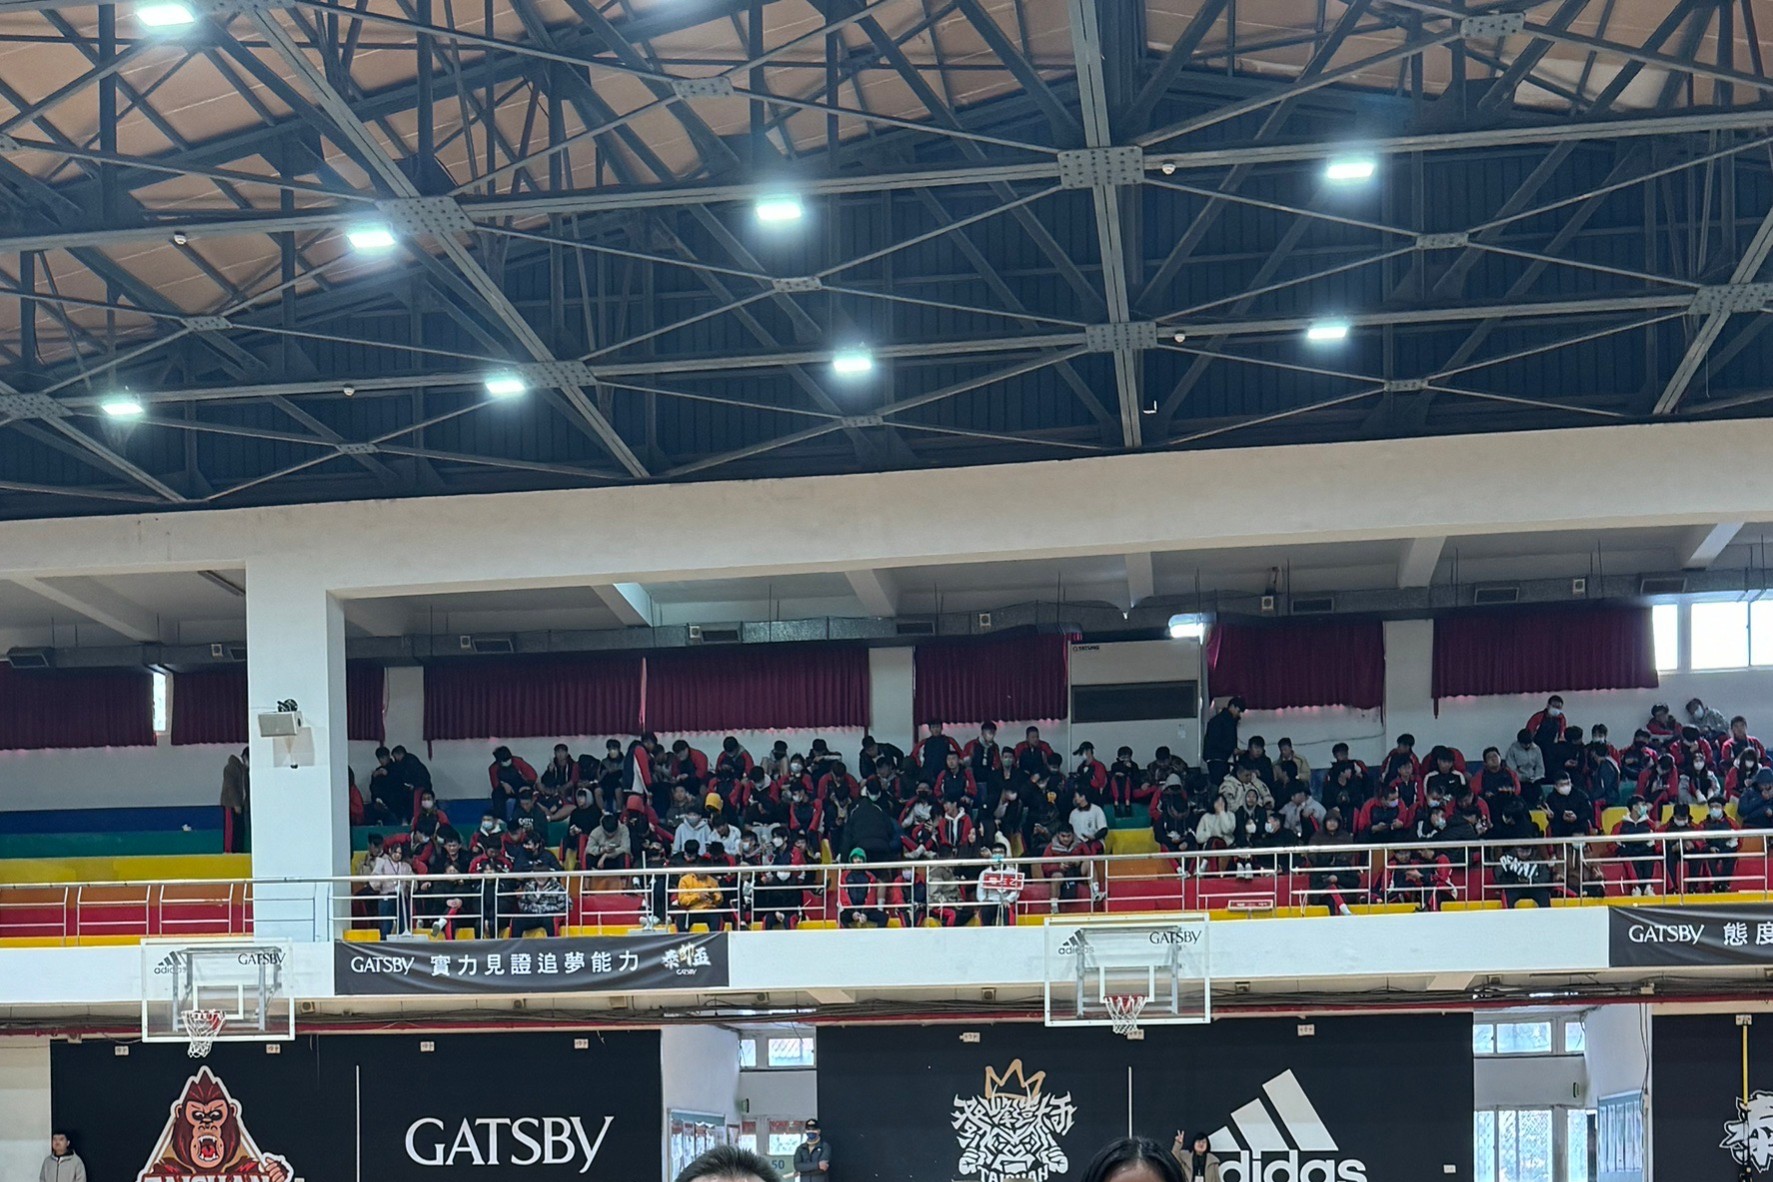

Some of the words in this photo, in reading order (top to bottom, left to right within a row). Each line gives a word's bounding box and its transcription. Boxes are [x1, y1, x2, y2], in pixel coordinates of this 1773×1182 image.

[1149, 930, 1201, 944] GATSBY
[1628, 924, 1705, 945] GATSBY
[1723, 921, 1773, 946] 態度
[238, 953, 286, 965] GATSBY
[351, 955, 415, 975] GATSBY
[430, 950, 640, 977] 實力見證追夢能力
[405, 1116, 615, 1174] GATSBY
